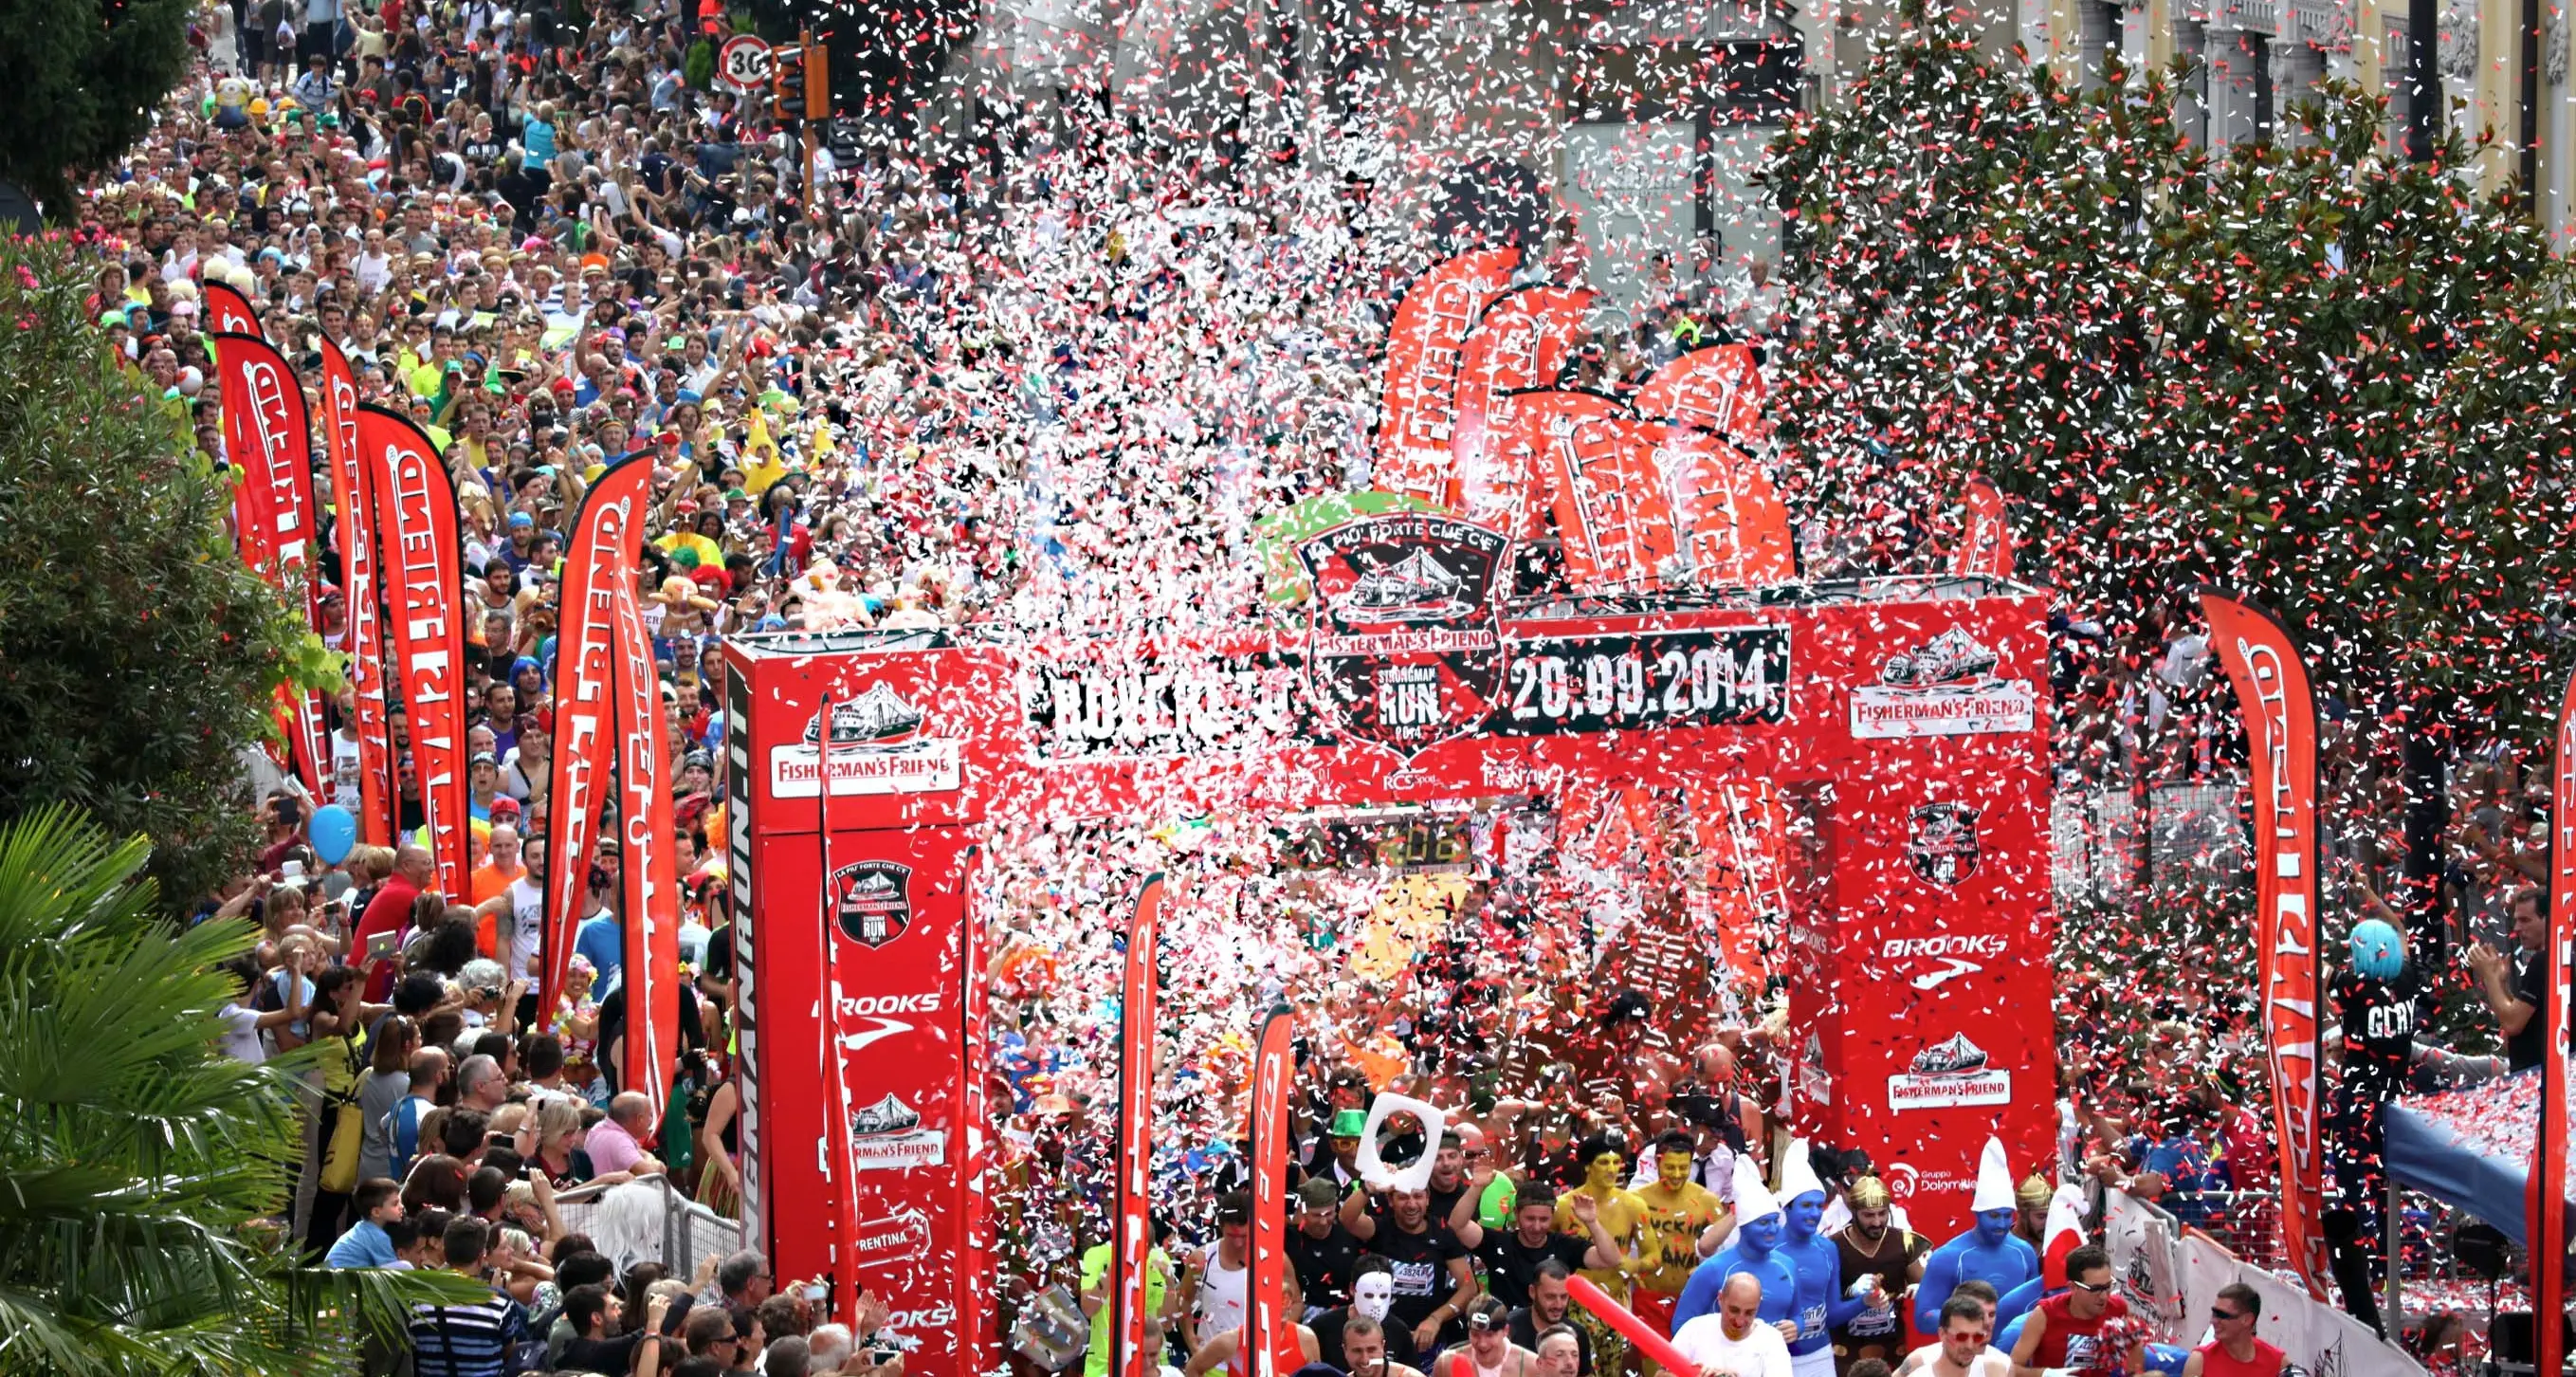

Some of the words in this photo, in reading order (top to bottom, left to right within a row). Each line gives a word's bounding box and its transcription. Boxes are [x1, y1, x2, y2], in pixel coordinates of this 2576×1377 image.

[731, 51, 761, 75] 30
[1318, 630, 1428, 653] ISHERMAN'S
[1510, 647, 1766, 718] 20.09.2014
[1379, 683, 1438, 725] RUN
[1857, 698, 1964, 722] FISHERMAN'S
[778, 758, 887, 782] FISHRMAN'S
[864, 921, 886, 937] RUN
[1883, 934, 2008, 958] BROOKS
[812, 993, 941, 1018] ROOKS
[1964, 1082, 2005, 1097] FRIEND
[855, 1144, 896, 1158] RMAN'S
[897, 1142, 939, 1157] FRIEND
[1921, 1170, 1951, 1180] Gruppo
[856, 1231, 907, 1252] RENTINA
